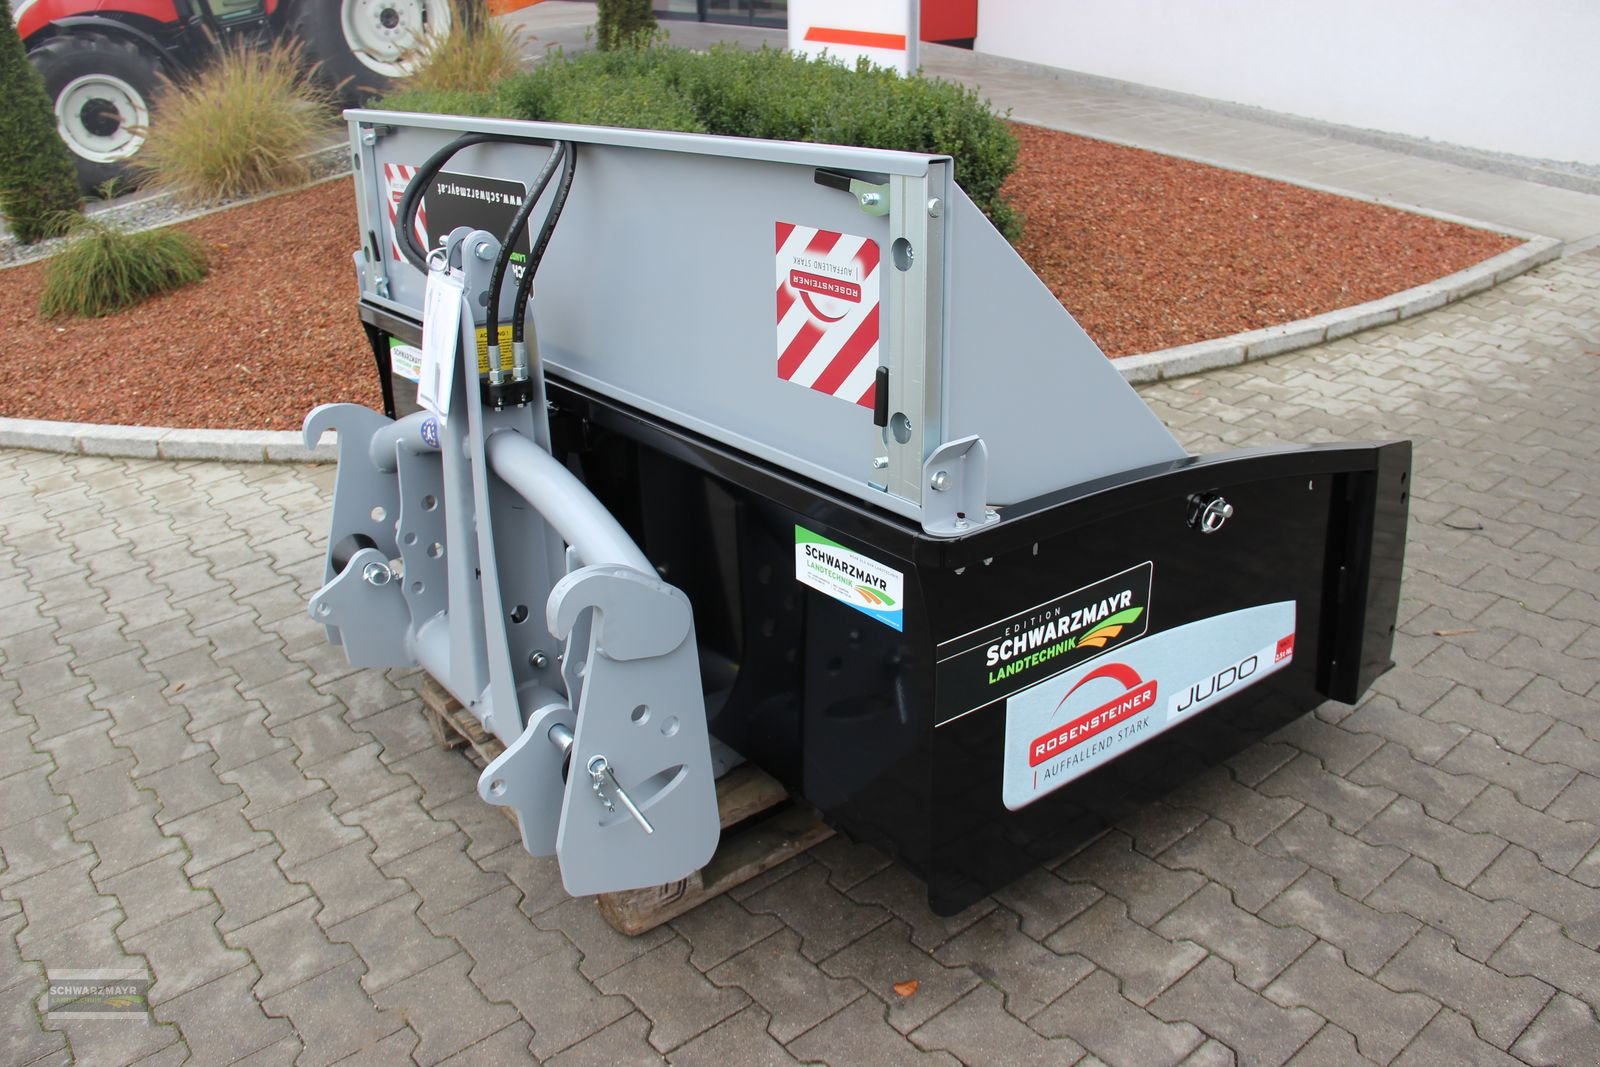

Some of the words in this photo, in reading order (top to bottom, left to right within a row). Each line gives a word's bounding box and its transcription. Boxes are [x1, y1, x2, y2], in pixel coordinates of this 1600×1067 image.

[793, 256, 812, 268] STARK
[813, 260, 853, 277] AUFFALLEND
[793, 275, 859, 297] ROSENSTEINER
[805, 544, 887, 591] SCHWARZMAYR
[806, 559, 854, 588] LANDTECHNIK
[986, 590, 1132, 666] SCHWARZMAYR
[1005, 607, 1061, 636] EDITION
[989, 637, 1076, 685] LANDTECHNIK
[1177, 655, 1258, 712] JUDO
[1036, 690, 1152, 757] ROSENSTEINER
[1043, 737, 1113, 781] AUFFALLEND
[1118, 717, 1150, 742] STARK
